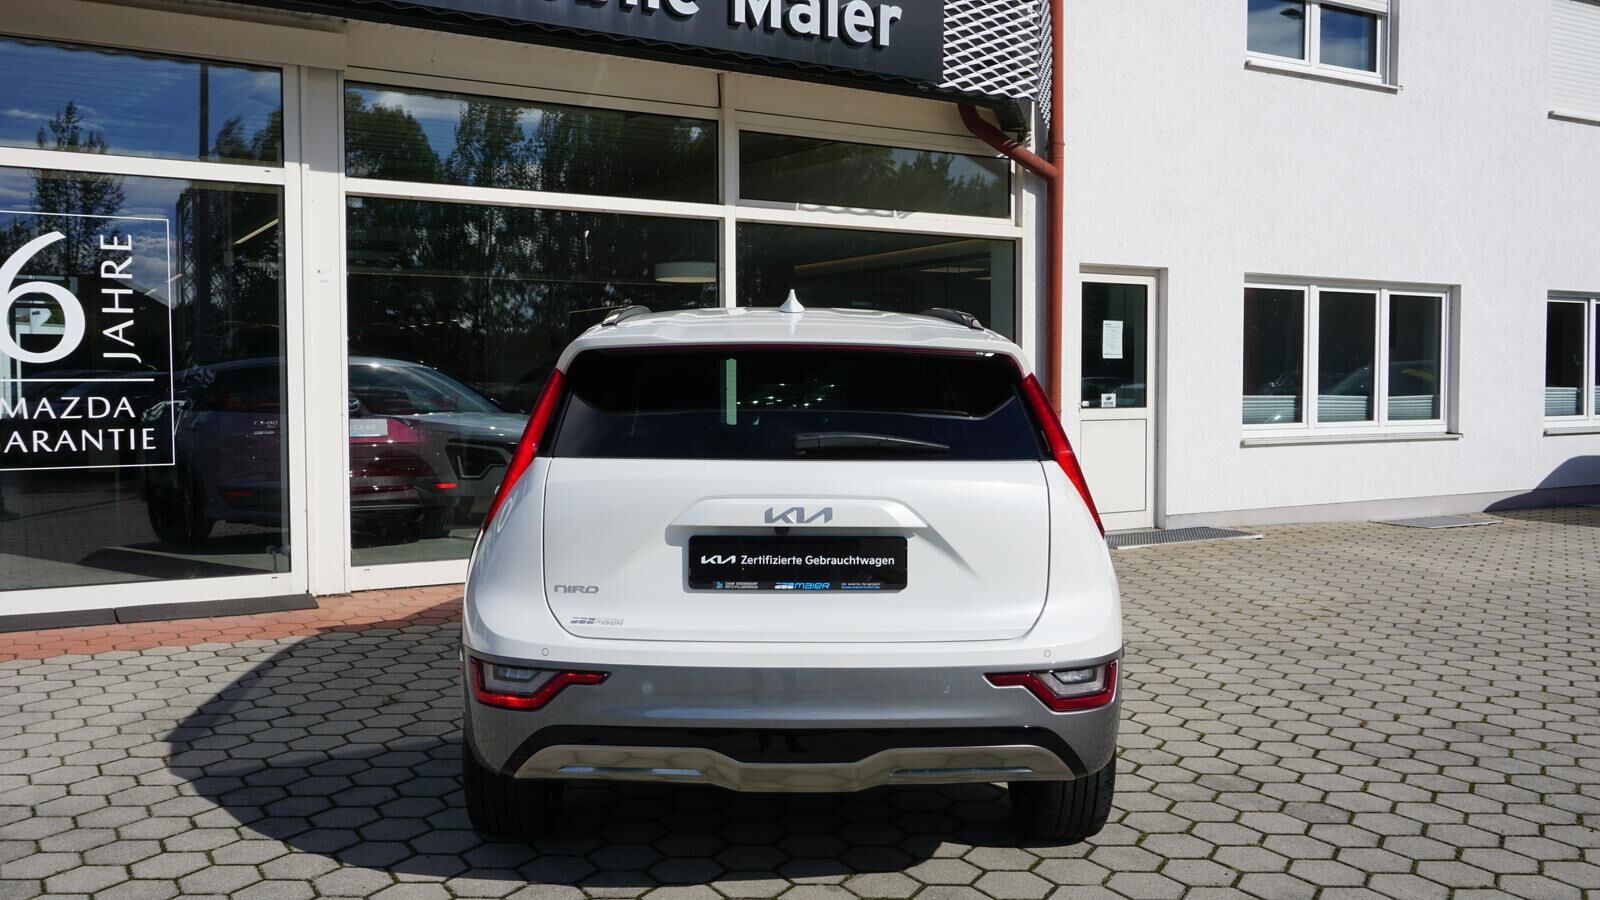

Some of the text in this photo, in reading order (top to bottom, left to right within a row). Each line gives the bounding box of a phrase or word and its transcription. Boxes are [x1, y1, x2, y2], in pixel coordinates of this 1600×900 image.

[0, 231, 86, 364] 6
[100, 234, 142, 364] JAHRE
[0, 396, 136, 420] MAZDA
[740, 555, 803, 565] Zertifizierte
[805, 555, 895, 567] Gebrauchtwagen
